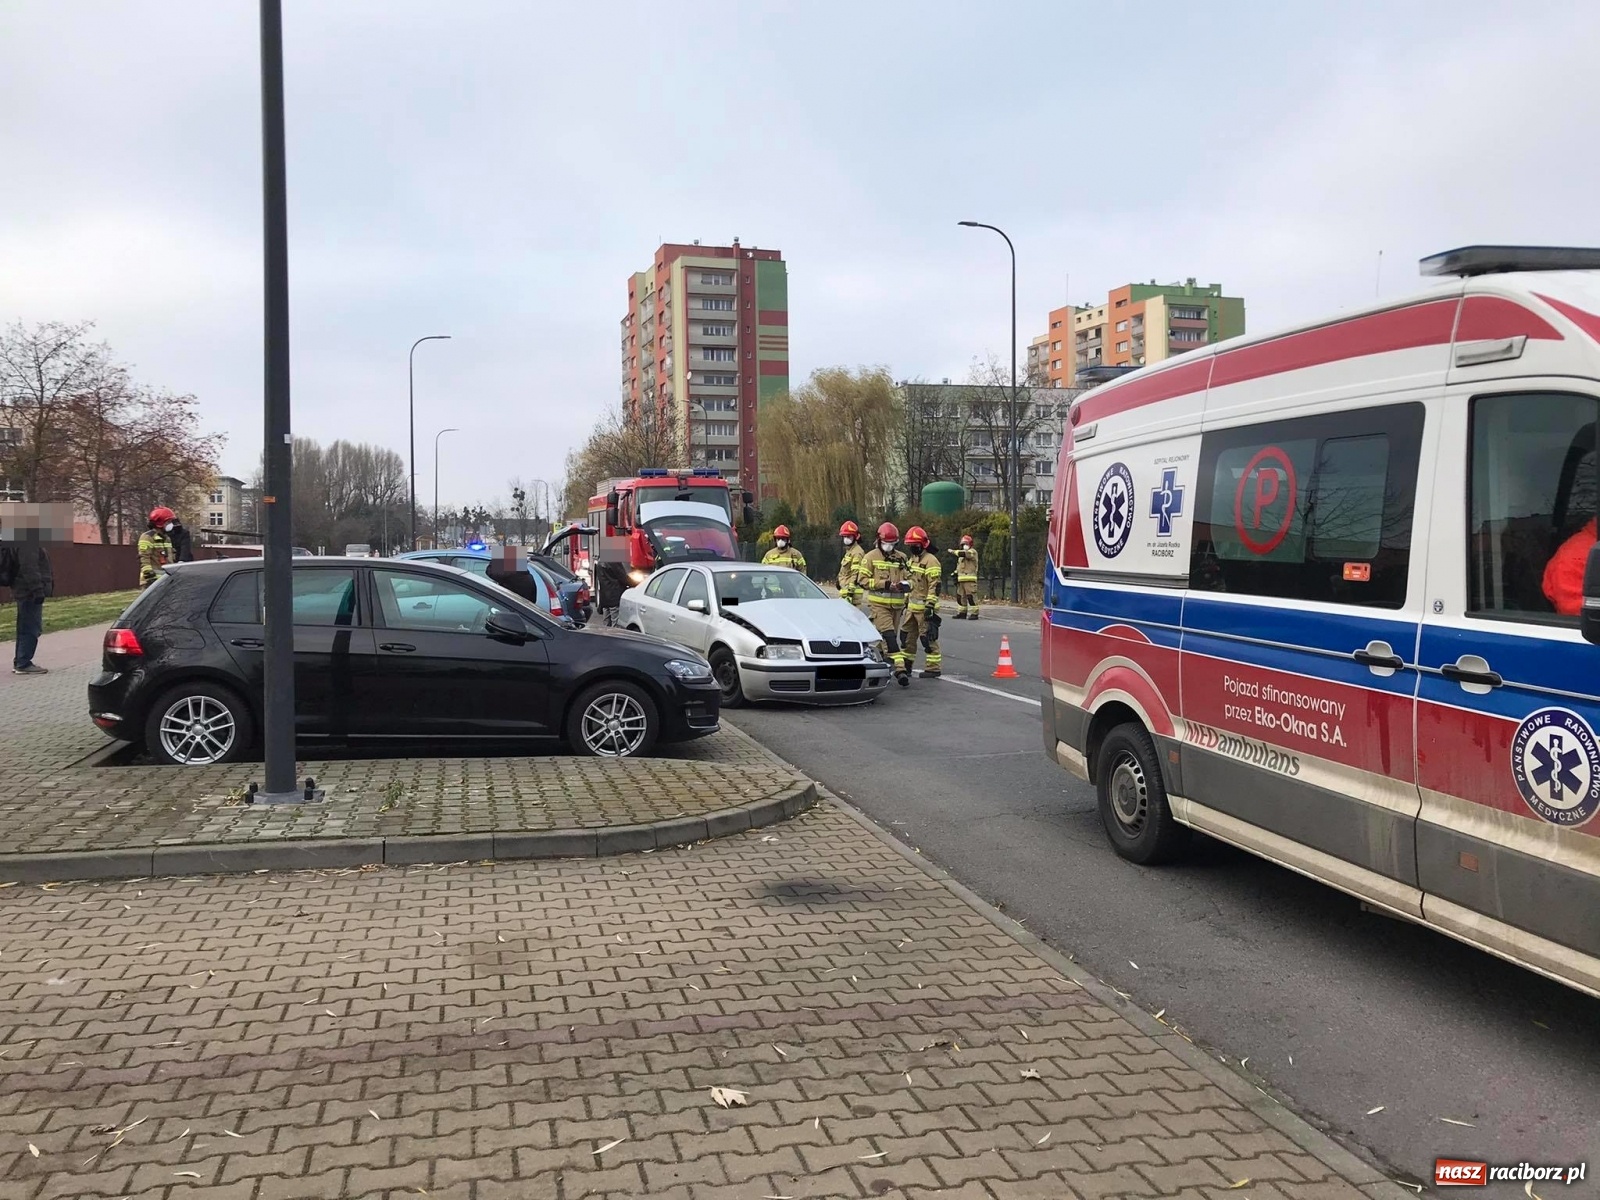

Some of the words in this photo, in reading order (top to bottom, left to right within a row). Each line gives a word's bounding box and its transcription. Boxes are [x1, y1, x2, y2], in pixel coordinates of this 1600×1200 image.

[1254, 467, 1279, 529] P
[1098, 538, 1124, 556] MEDYCZNE
[1223, 675, 1259, 699] Pojazd
[1261, 684, 1346, 721] sfinansowany
[1184, 720, 1301, 776] MEDambulans
[1224, 702, 1252, 723] przez
[1254, 705, 1317, 740] Eko-Okna
[1321, 722, 1348, 748] S.A.
[1564, 717, 1600, 799] RATOWNICTWO
[1529, 794, 1587, 822] MEDYCZNE
